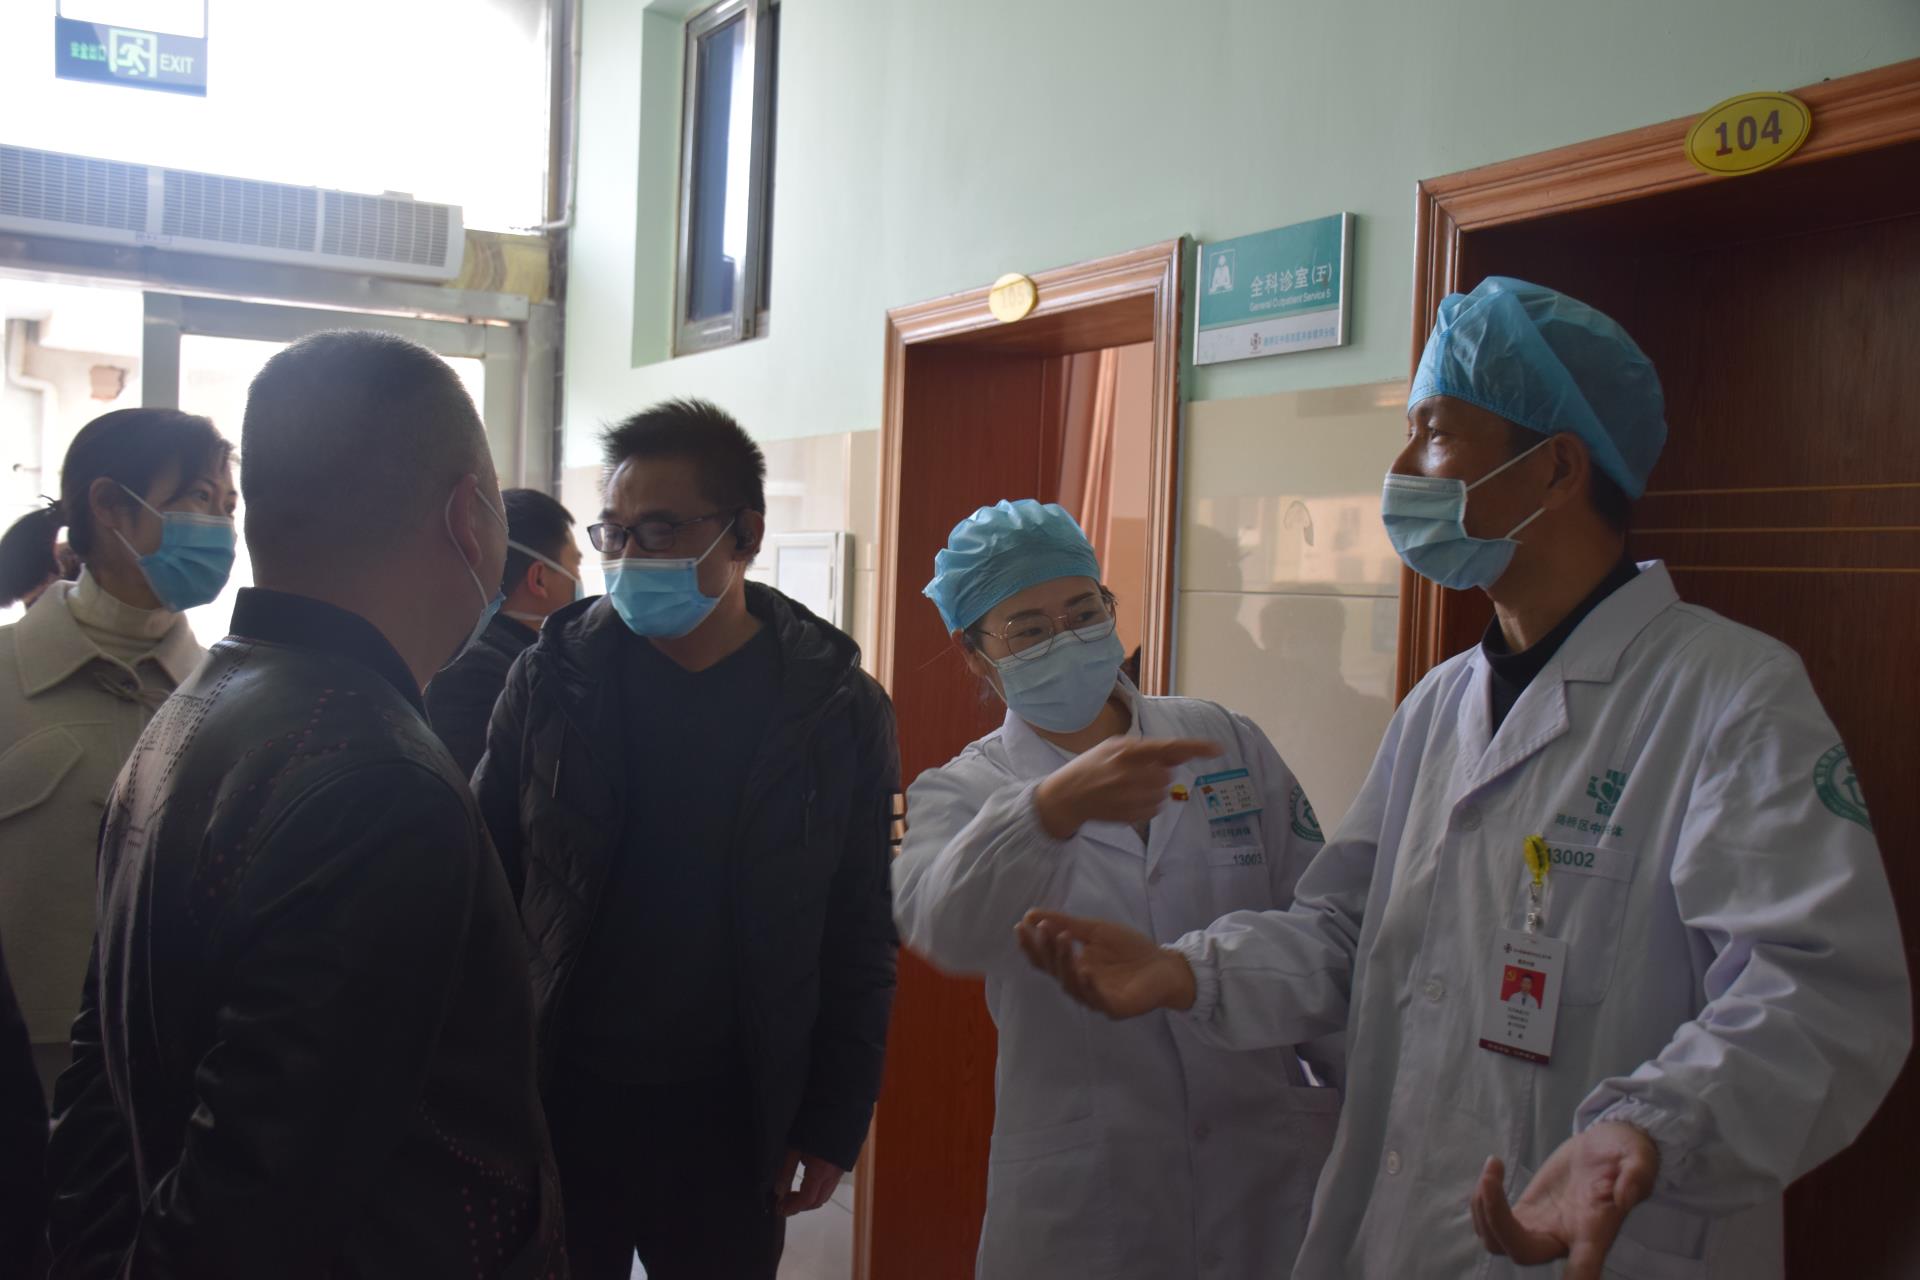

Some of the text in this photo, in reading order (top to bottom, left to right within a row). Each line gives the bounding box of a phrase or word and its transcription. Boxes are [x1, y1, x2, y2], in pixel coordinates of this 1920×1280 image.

[160, 54, 194, 74] EXIT
[1715, 109, 1783, 157] 104
[1249, 299, 1271, 312] General
[1304, 291, 1325, 302] Service
[1547, 848, 1596, 868] 13002
